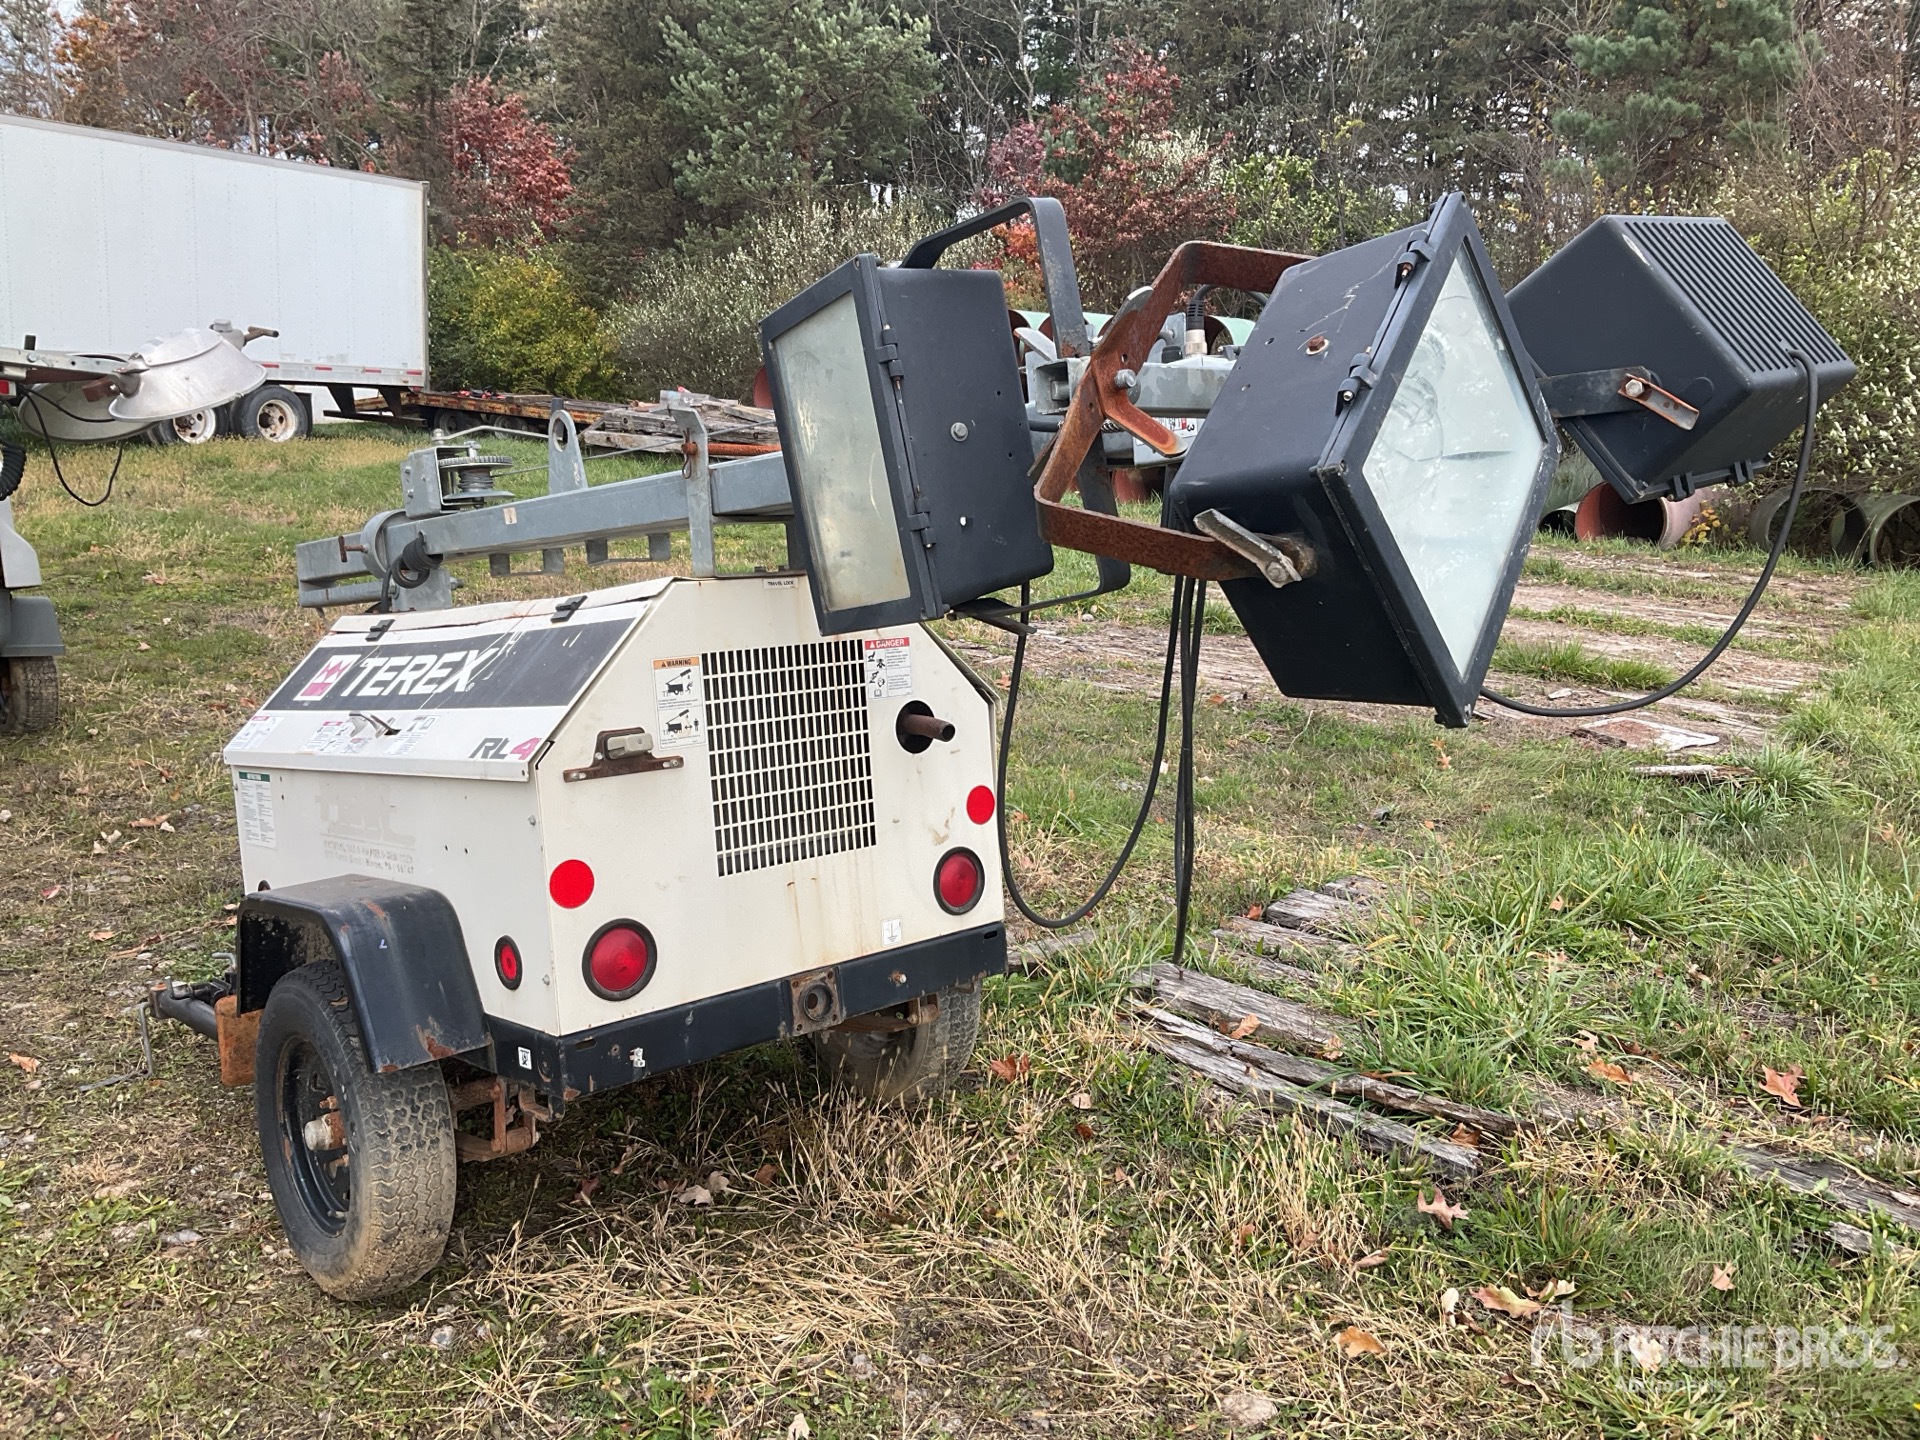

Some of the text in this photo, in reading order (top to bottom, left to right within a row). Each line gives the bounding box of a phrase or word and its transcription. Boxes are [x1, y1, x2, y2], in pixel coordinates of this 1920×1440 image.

[875, 638, 905, 648] DANGER
[667, 658, 692, 668] WARNING
[341, 648, 497, 697] TEREX
[469, 737, 541, 760] RL4
